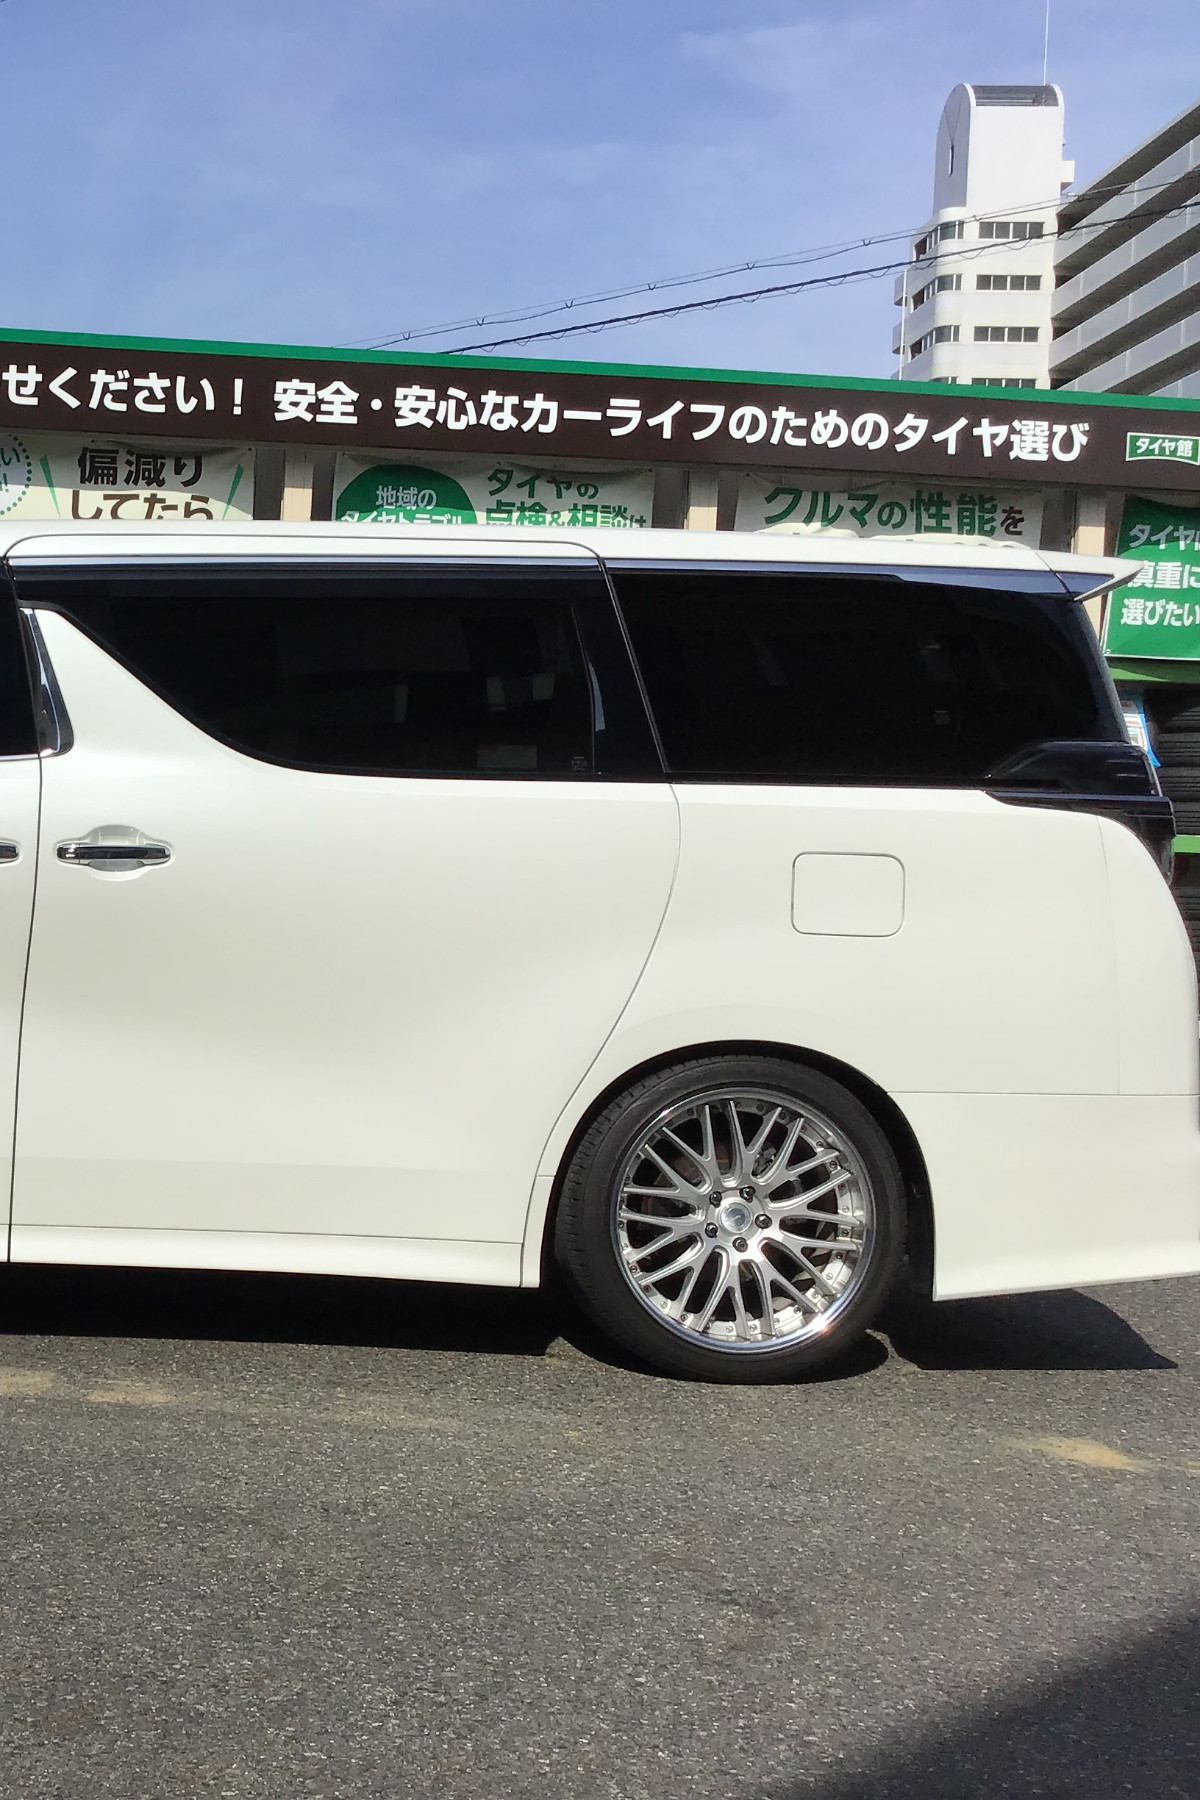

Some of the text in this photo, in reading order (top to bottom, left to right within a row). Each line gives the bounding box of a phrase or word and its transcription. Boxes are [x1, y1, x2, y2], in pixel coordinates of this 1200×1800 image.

[274, 379, 1090, 462] 安全・安心なカーライフのためのタイヤ選び
[1136, 437, 1193, 457] タイヤ館
[78, 447, 203, 488] 偏減り
[376, 485, 437, 509] 地域の
[487, 468, 599, 499] タイヤの
[71, 489, 214, 520] してたら
[764, 486, 1025, 536] クルマの性能を
[1120, 598, 1200, 627] 選びたい
